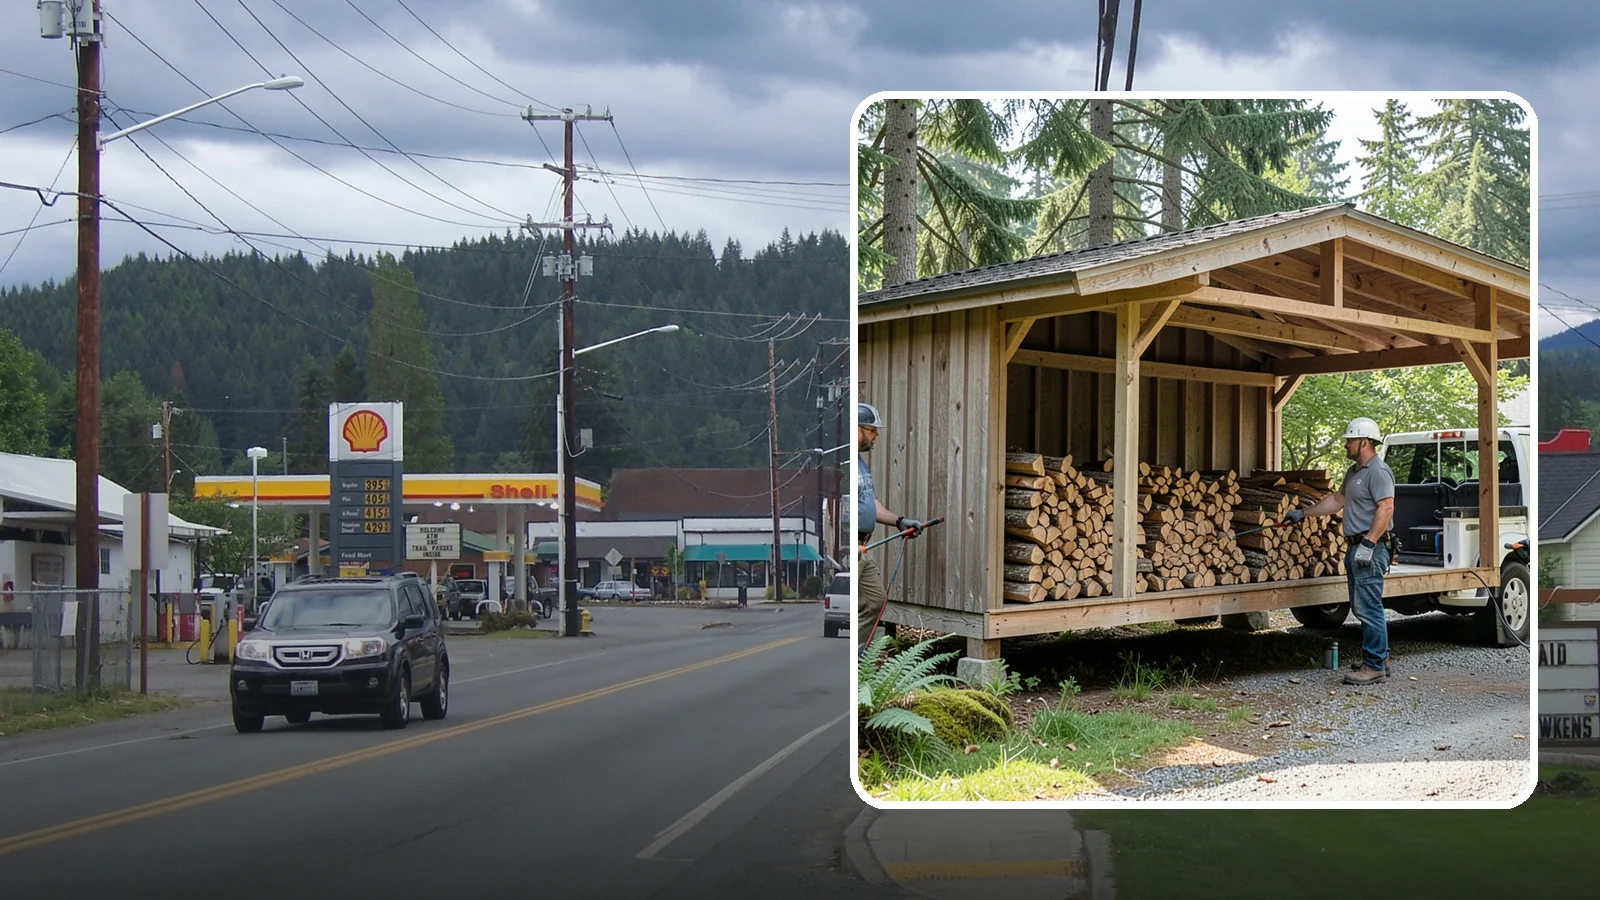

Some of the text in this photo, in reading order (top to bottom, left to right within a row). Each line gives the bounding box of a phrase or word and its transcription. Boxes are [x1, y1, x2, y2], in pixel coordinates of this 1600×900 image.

[366, 480, 383, 490] 395
[490, 484, 547, 499] Shell
[366, 494, 383, 504] 405
[366, 508, 383, 518] 415
[366, 522, 383, 532] 429
